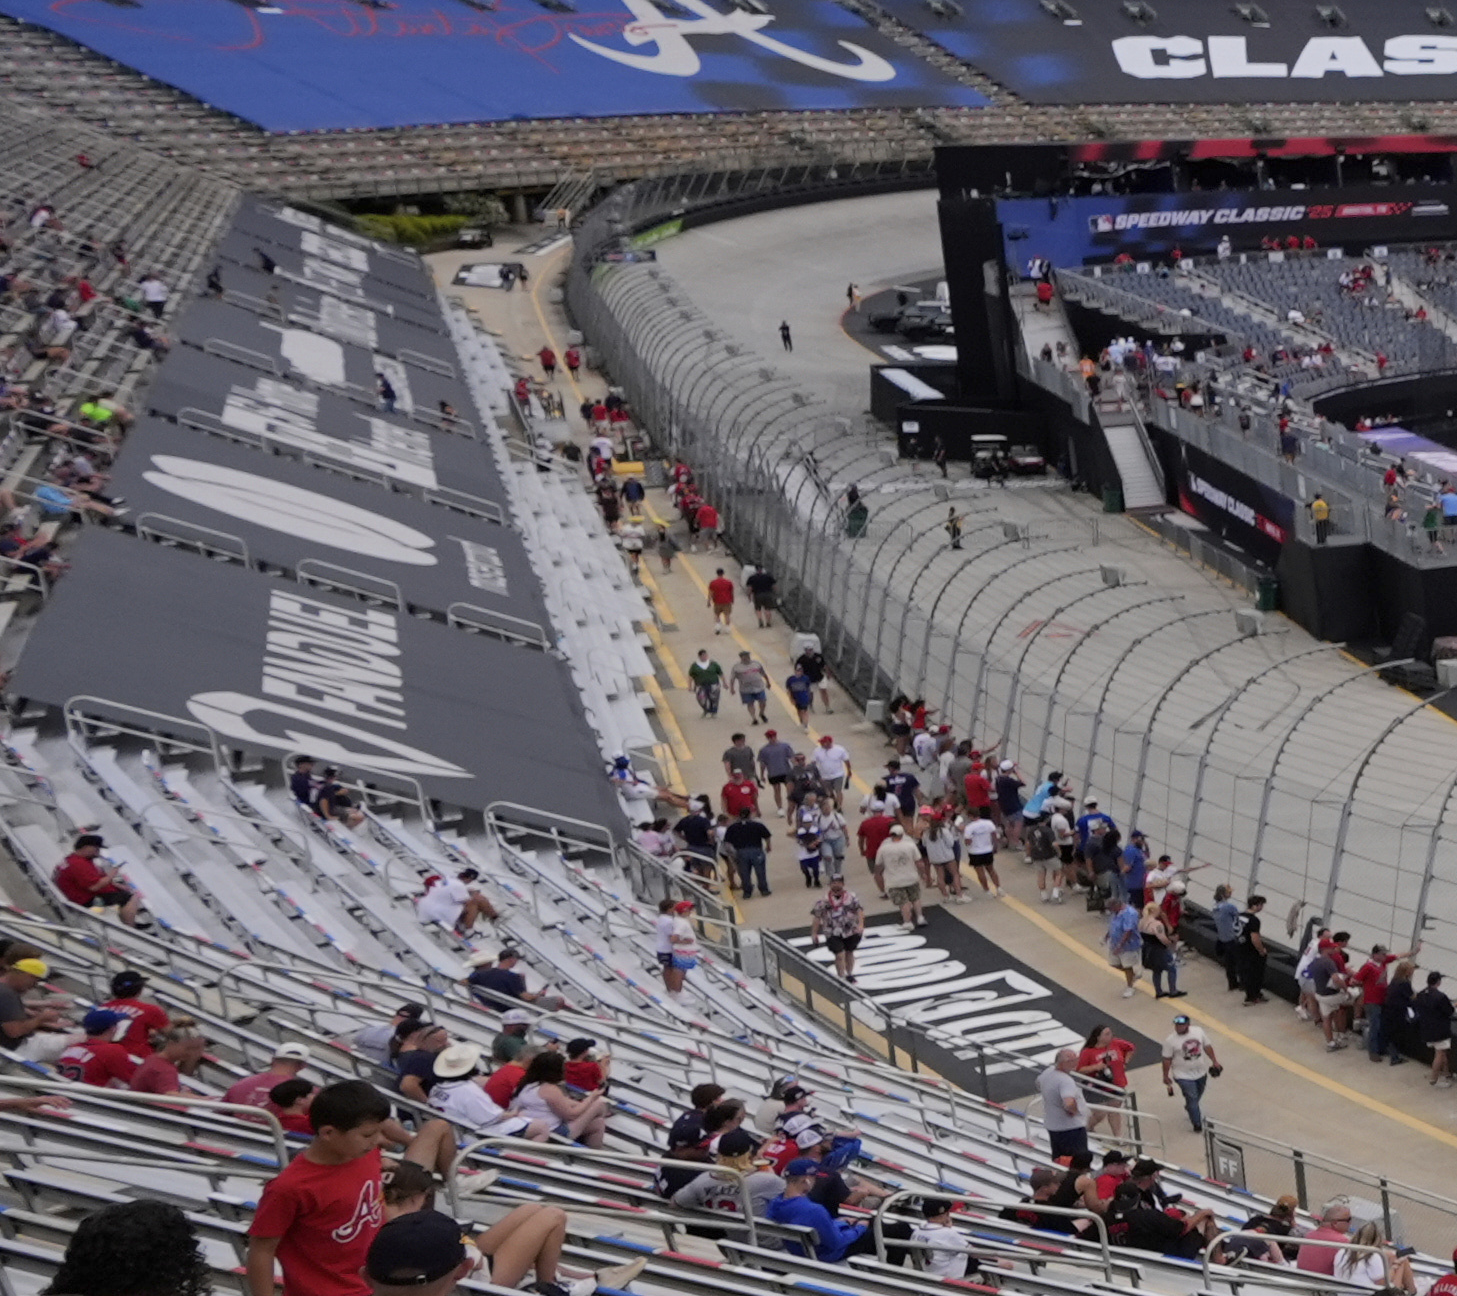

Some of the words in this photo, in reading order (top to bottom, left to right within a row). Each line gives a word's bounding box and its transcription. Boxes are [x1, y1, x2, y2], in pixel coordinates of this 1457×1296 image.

[1115, 209, 1214, 230] SPEEDWAY
[1214, 205, 1305, 224] CLASSIC
[261, 588, 408, 730] FANDUEL
[1219, 1156, 1238, 1177] FF
